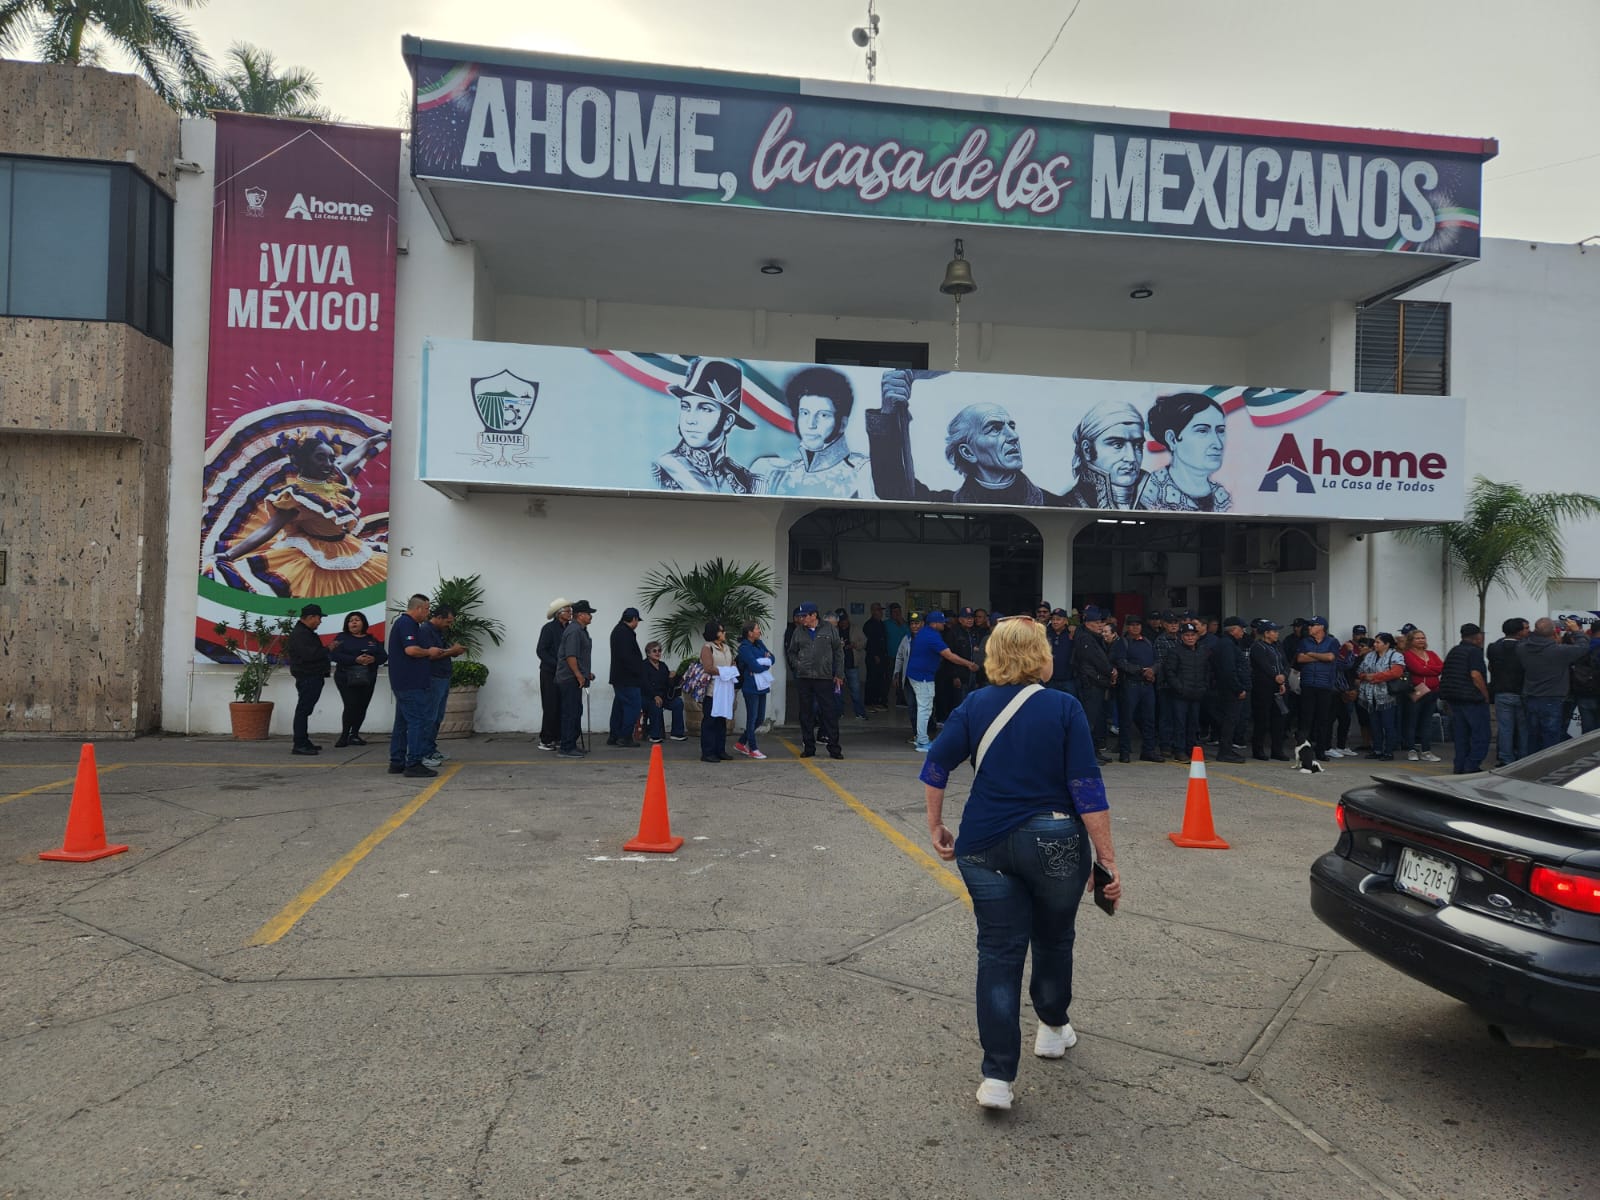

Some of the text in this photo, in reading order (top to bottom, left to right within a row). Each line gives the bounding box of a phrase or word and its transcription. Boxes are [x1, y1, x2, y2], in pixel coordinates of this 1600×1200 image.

[461, 75, 1438, 242] AHOME, la casa de los MEXICANOS
[284, 193, 374, 220] Ahome
[259, 242, 354, 286] ¡VIVA
[227, 281, 379, 332] MÉXICO!
[485, 434, 523, 444] AHOME
[1258, 433, 1448, 494] Ahome
[1321, 478, 1435, 493] La Casa de Todos
